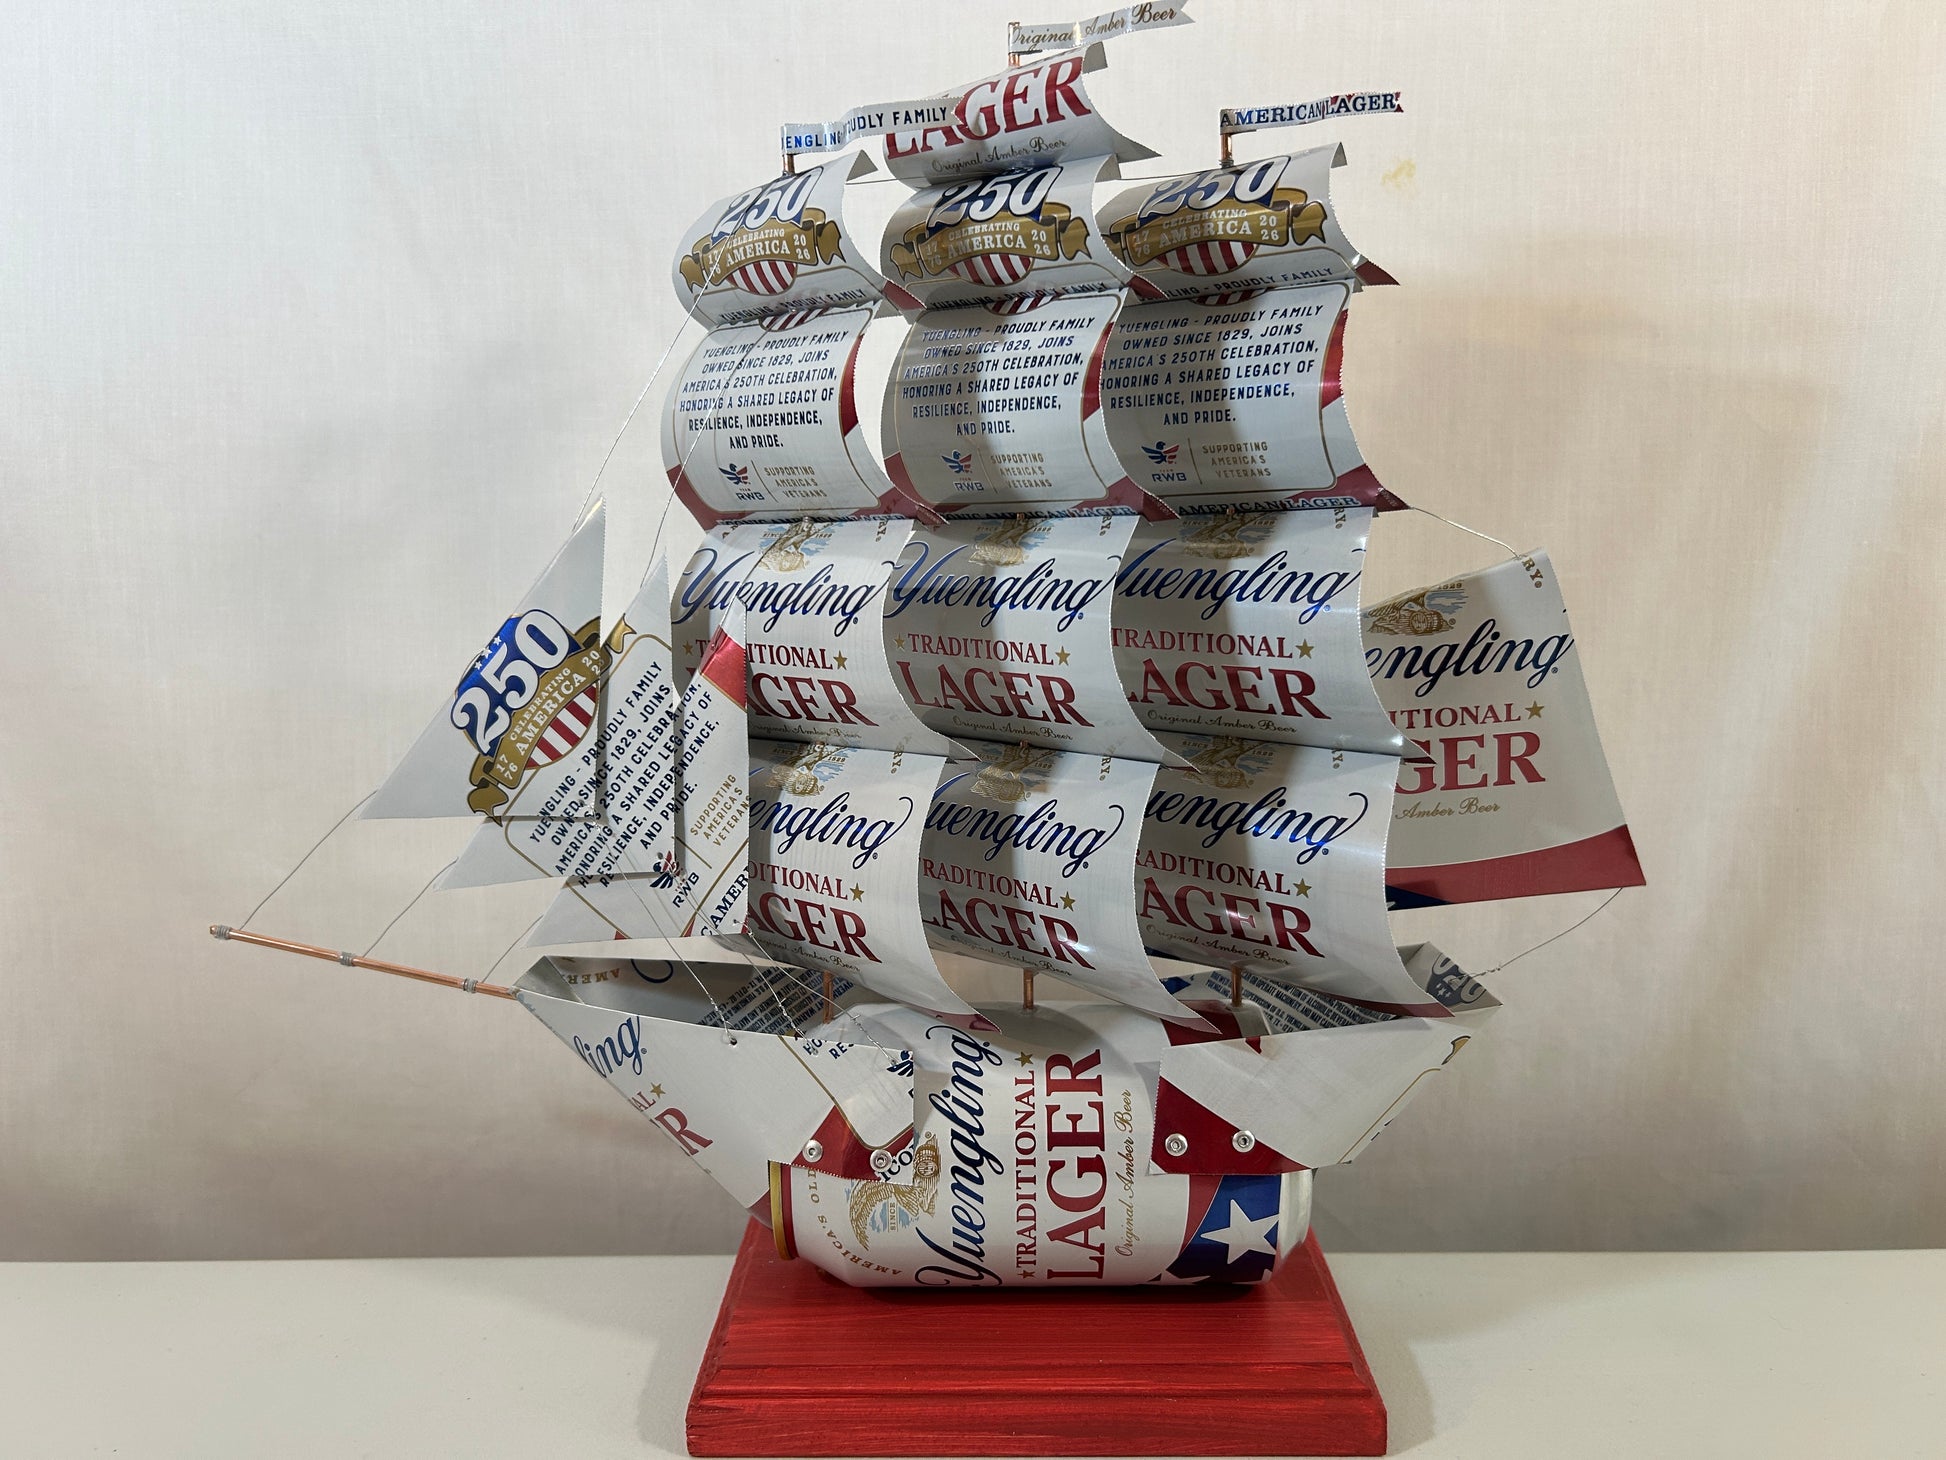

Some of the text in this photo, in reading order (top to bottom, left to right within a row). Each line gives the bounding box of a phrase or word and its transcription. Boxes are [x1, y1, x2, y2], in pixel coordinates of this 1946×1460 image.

[1085, 2, 1177, 36] Amber Beer
[892, 107, 947, 126] FAMILY
[1220, 93, 1395, 128] AMERICAN LAGER
[1029, 137, 1069, 155] Beer
[928, 166, 1063, 228] 250
[1139, 155, 1291, 219] 250
[711, 167, 824, 239] 250
[1162, 209, 1247, 229] CELEBRATING
[1260, 215, 1277, 227] 20
[727, 228, 785, 249] CELEBRATING
[794, 234, 806, 246] 20
[949, 223, 1020, 241] CELEBRATING
[1032, 229, 1046, 241] 20
[1159, 221, 1252, 248] AMERICA
[1261, 229, 1280, 241] 26
[726, 240, 790, 267] AMERICA
[796, 248, 811, 260] 26
[948, 235, 1027, 259] AMERICA
[1035, 243, 1050, 255] 26
[1216, 268, 1334, 292] PROUDLY FAMILY
[922, 317, 1095, 342] YUENGLING PROUDLY FAMILY
[1119, 305, 1324, 334] YUENGLING PROUDLY FAMILY
[703, 331, 848, 358] YUENGLING PROUDLY FAMILY
[924, 335, 1074, 359] OWNED SINCE 1829, JOINS
[1122, 323, 1303, 351] OWNED SINCE 1829, JOINS
[702, 350, 829, 374] OWNED SINCE 1829, JOINS
[962, 359, 998, 374] 250TH
[1002, 353, 1083, 370] CELEBRATION,
[1171, 349, 1215, 364] 250TH
[1221, 340, 1319, 360] CELEBRATION,
[734, 374, 765, 388] 250TH
[768, 367, 837, 385] CELEBRATION,
[1165, 372, 1172, 385] A
[1178, 366, 1230, 383] SHARED
[1236, 361, 1290, 379] LEGACY
[1297, 359, 1315, 374] OF
[902, 372, 1079, 399] HONORING A SHARED LEGACY OF
[1110, 382, 1295, 409] RESILIENCE, INDEPENDENCE,
[680, 387, 834, 412] HONORING A SHARED LEGACY OF
[913, 395, 1061, 418] RESILIENCE, INDEPENDENCE,
[746, 410, 822, 428] INDEPENDENCE,
[957, 420, 1015, 436] AND PRIDE.
[1163, 409, 1236, 426] AND PRIDE.
[729, 434, 784, 449] AND PRIDE.
[1202, 441, 1268, 454] SUPPORTING
[990, 452, 1044, 464] SUPPORTING
[764, 466, 815, 476] SUPPORTING
[1151, 472, 1187, 482] RWB
[1215, 468, 1272, 479] VETERANS
[736, 492, 765, 500] RWB
[783, 489, 827, 498] VETERANS
[953, 481, 984, 492] RWB
[1006, 479, 1052, 489] VETERANS
[1288, 496, 1360, 509] LAGER
[883, 541, 1122, 632] Yuengling
[908, 633, 1054, 665] TRADITIONAL
[1111, 627, 1293, 659] TRADITIONAL
[581, 651, 600, 667] 20
[451, 609, 570, 755] 250
[896, 660, 1095, 728] LAGER
[510, 667, 571, 741] CELEBRATING
[515, 672, 587, 756] AMERICA
[582, 709, 628, 767] PROUDLY
[625, 661, 663, 708] FAMILY
[1147, 709, 1297, 734] Original Amber Beer
[579, 761, 613, 800] SINCE
[611, 729, 641, 760] 1829,
[640, 684, 670, 722] JOINS
[496, 754, 509, 772] 17
[614, 814, 623, 825] A
[620, 761, 661, 812] SHARED
[657, 713, 701, 759] LEGACY
[698, 692, 713, 711] OF
[504, 763, 519, 781] 76
[601, 766, 634, 809] 250TH
[640, 783, 698, 850] AND PRIDE.
[690, 774, 736, 836] SUPPORTING
[1395, 797, 1500, 819] Amber Beer
[672, 871, 700, 908] RWB
[919, 858, 1059, 909] RADITIONAL
[1140, 876, 1326, 958] AGER
[914, 1025, 1005, 1286] Yuengling
[1045, 1049, 1107, 1280] LAGER
[1014, 1070, 1037, 1269] TRADITIONAL
[1113, 1088, 1139, 1257] Original Amber Beer
[818, 1214, 903, 1276] AMERICA'S
